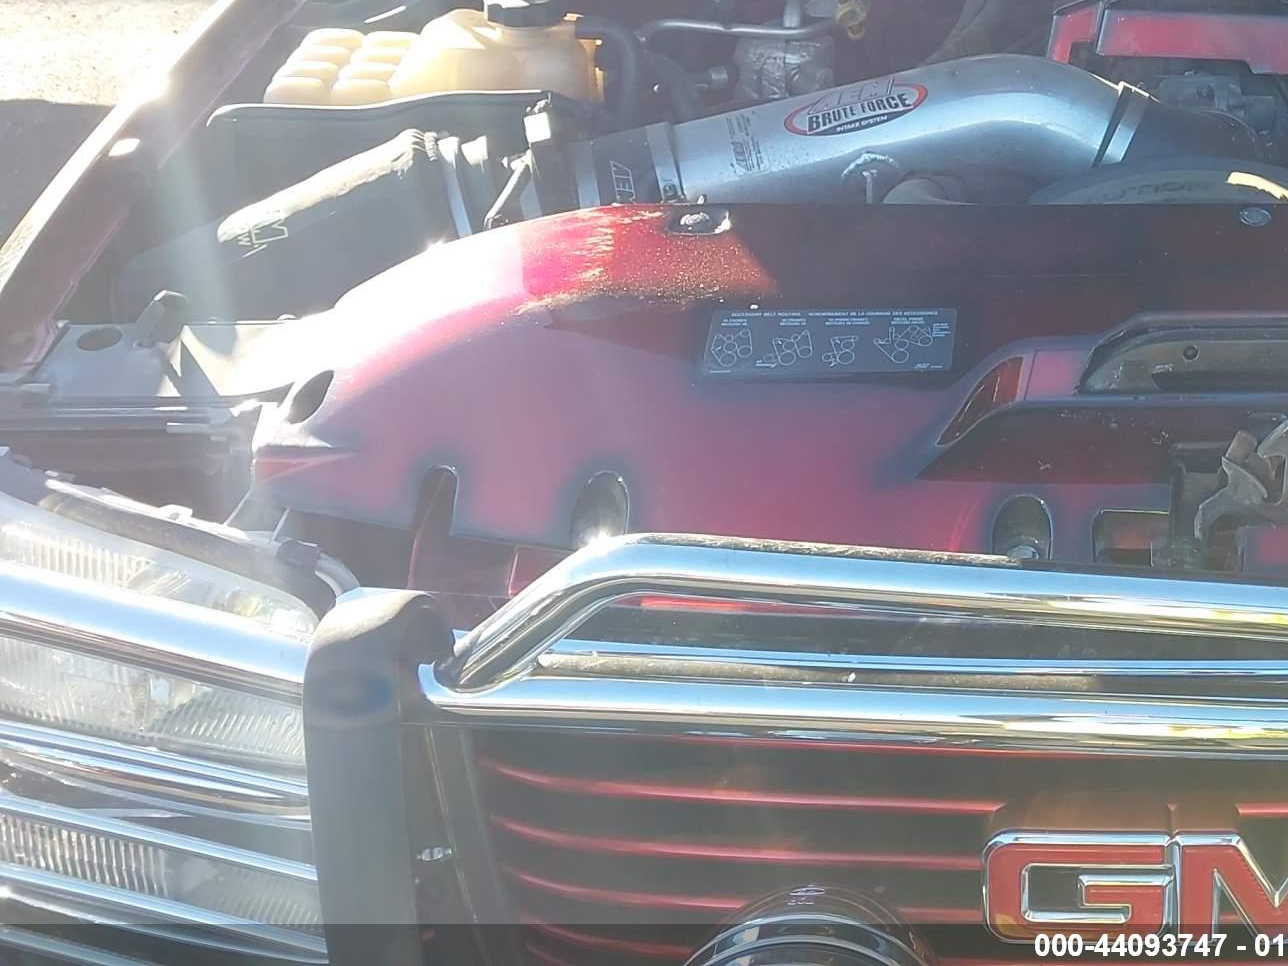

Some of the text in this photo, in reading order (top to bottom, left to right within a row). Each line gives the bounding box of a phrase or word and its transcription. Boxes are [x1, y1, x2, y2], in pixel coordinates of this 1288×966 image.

[808, 93, 913, 133] BRUTE FORCE
[836, 115, 888, 132] INTAKE SYSTEM
